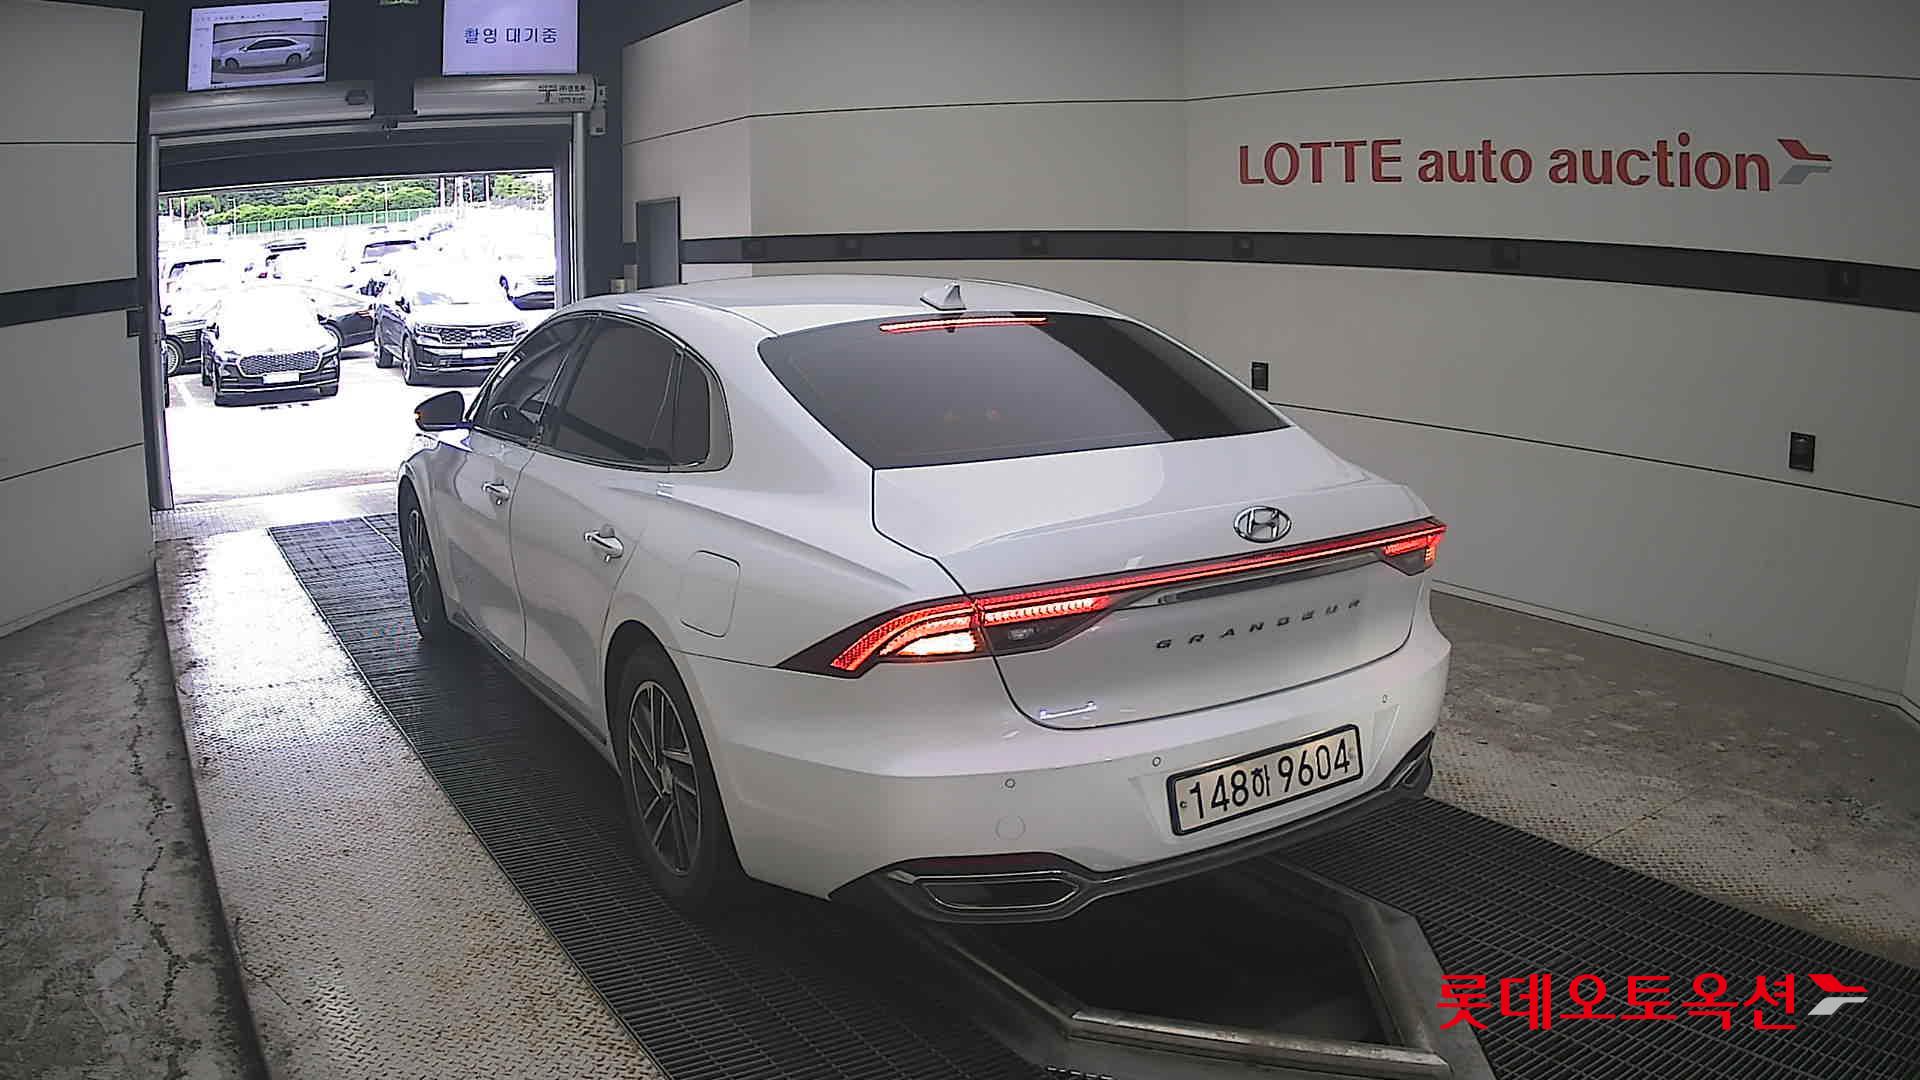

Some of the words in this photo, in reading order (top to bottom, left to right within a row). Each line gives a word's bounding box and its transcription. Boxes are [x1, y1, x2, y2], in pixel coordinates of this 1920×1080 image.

[506, 27, 558, 43] 대기중
[1238, 140, 1401, 185] LOTTE
[1417, 139, 1533, 184] auto
[1549, 131, 1771, 191] auction
[1156, 599, 1360, 649] GRANDEUR
[1278, 738, 1350, 793] 9604
